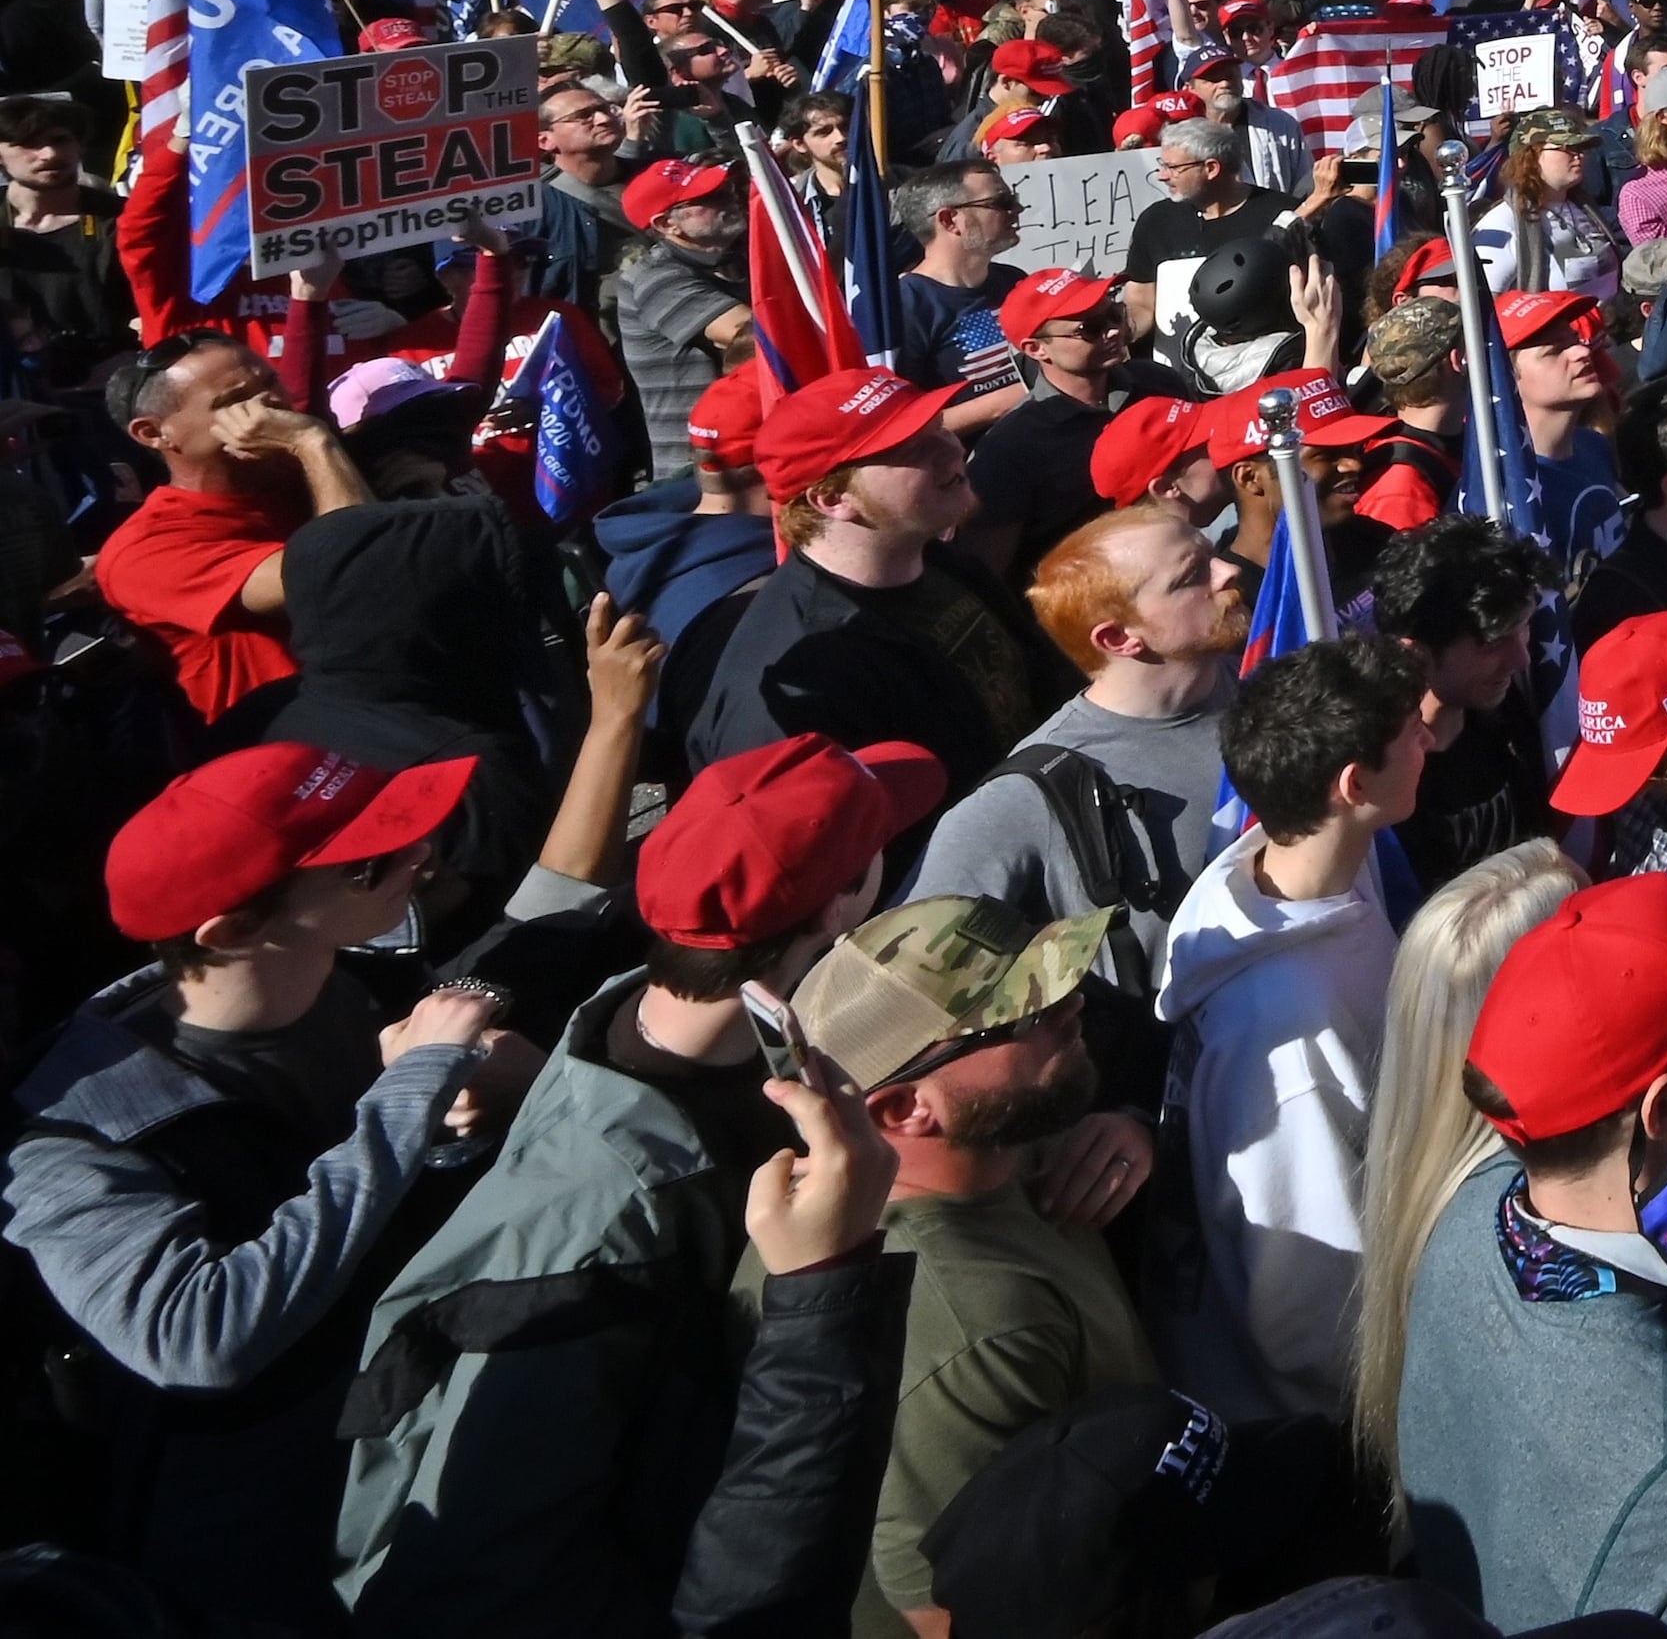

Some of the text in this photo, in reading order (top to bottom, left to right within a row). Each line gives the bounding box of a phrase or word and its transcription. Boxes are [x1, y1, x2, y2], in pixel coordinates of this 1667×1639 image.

[1488, 46, 1533, 68] STOP
[384, 70, 436, 89] STOP
[1496, 65, 1522, 82] THE
[384, 91, 437, 109] STEAL
[483, 88, 529, 110] THE
[1486, 82, 1538, 105] STEAL
[261, 122, 533, 224] STEAL
[260, 183, 536, 264] #StopTheSteal
[1032, 231, 1128, 264] THE
[547, 354, 605, 457] TRUMP
